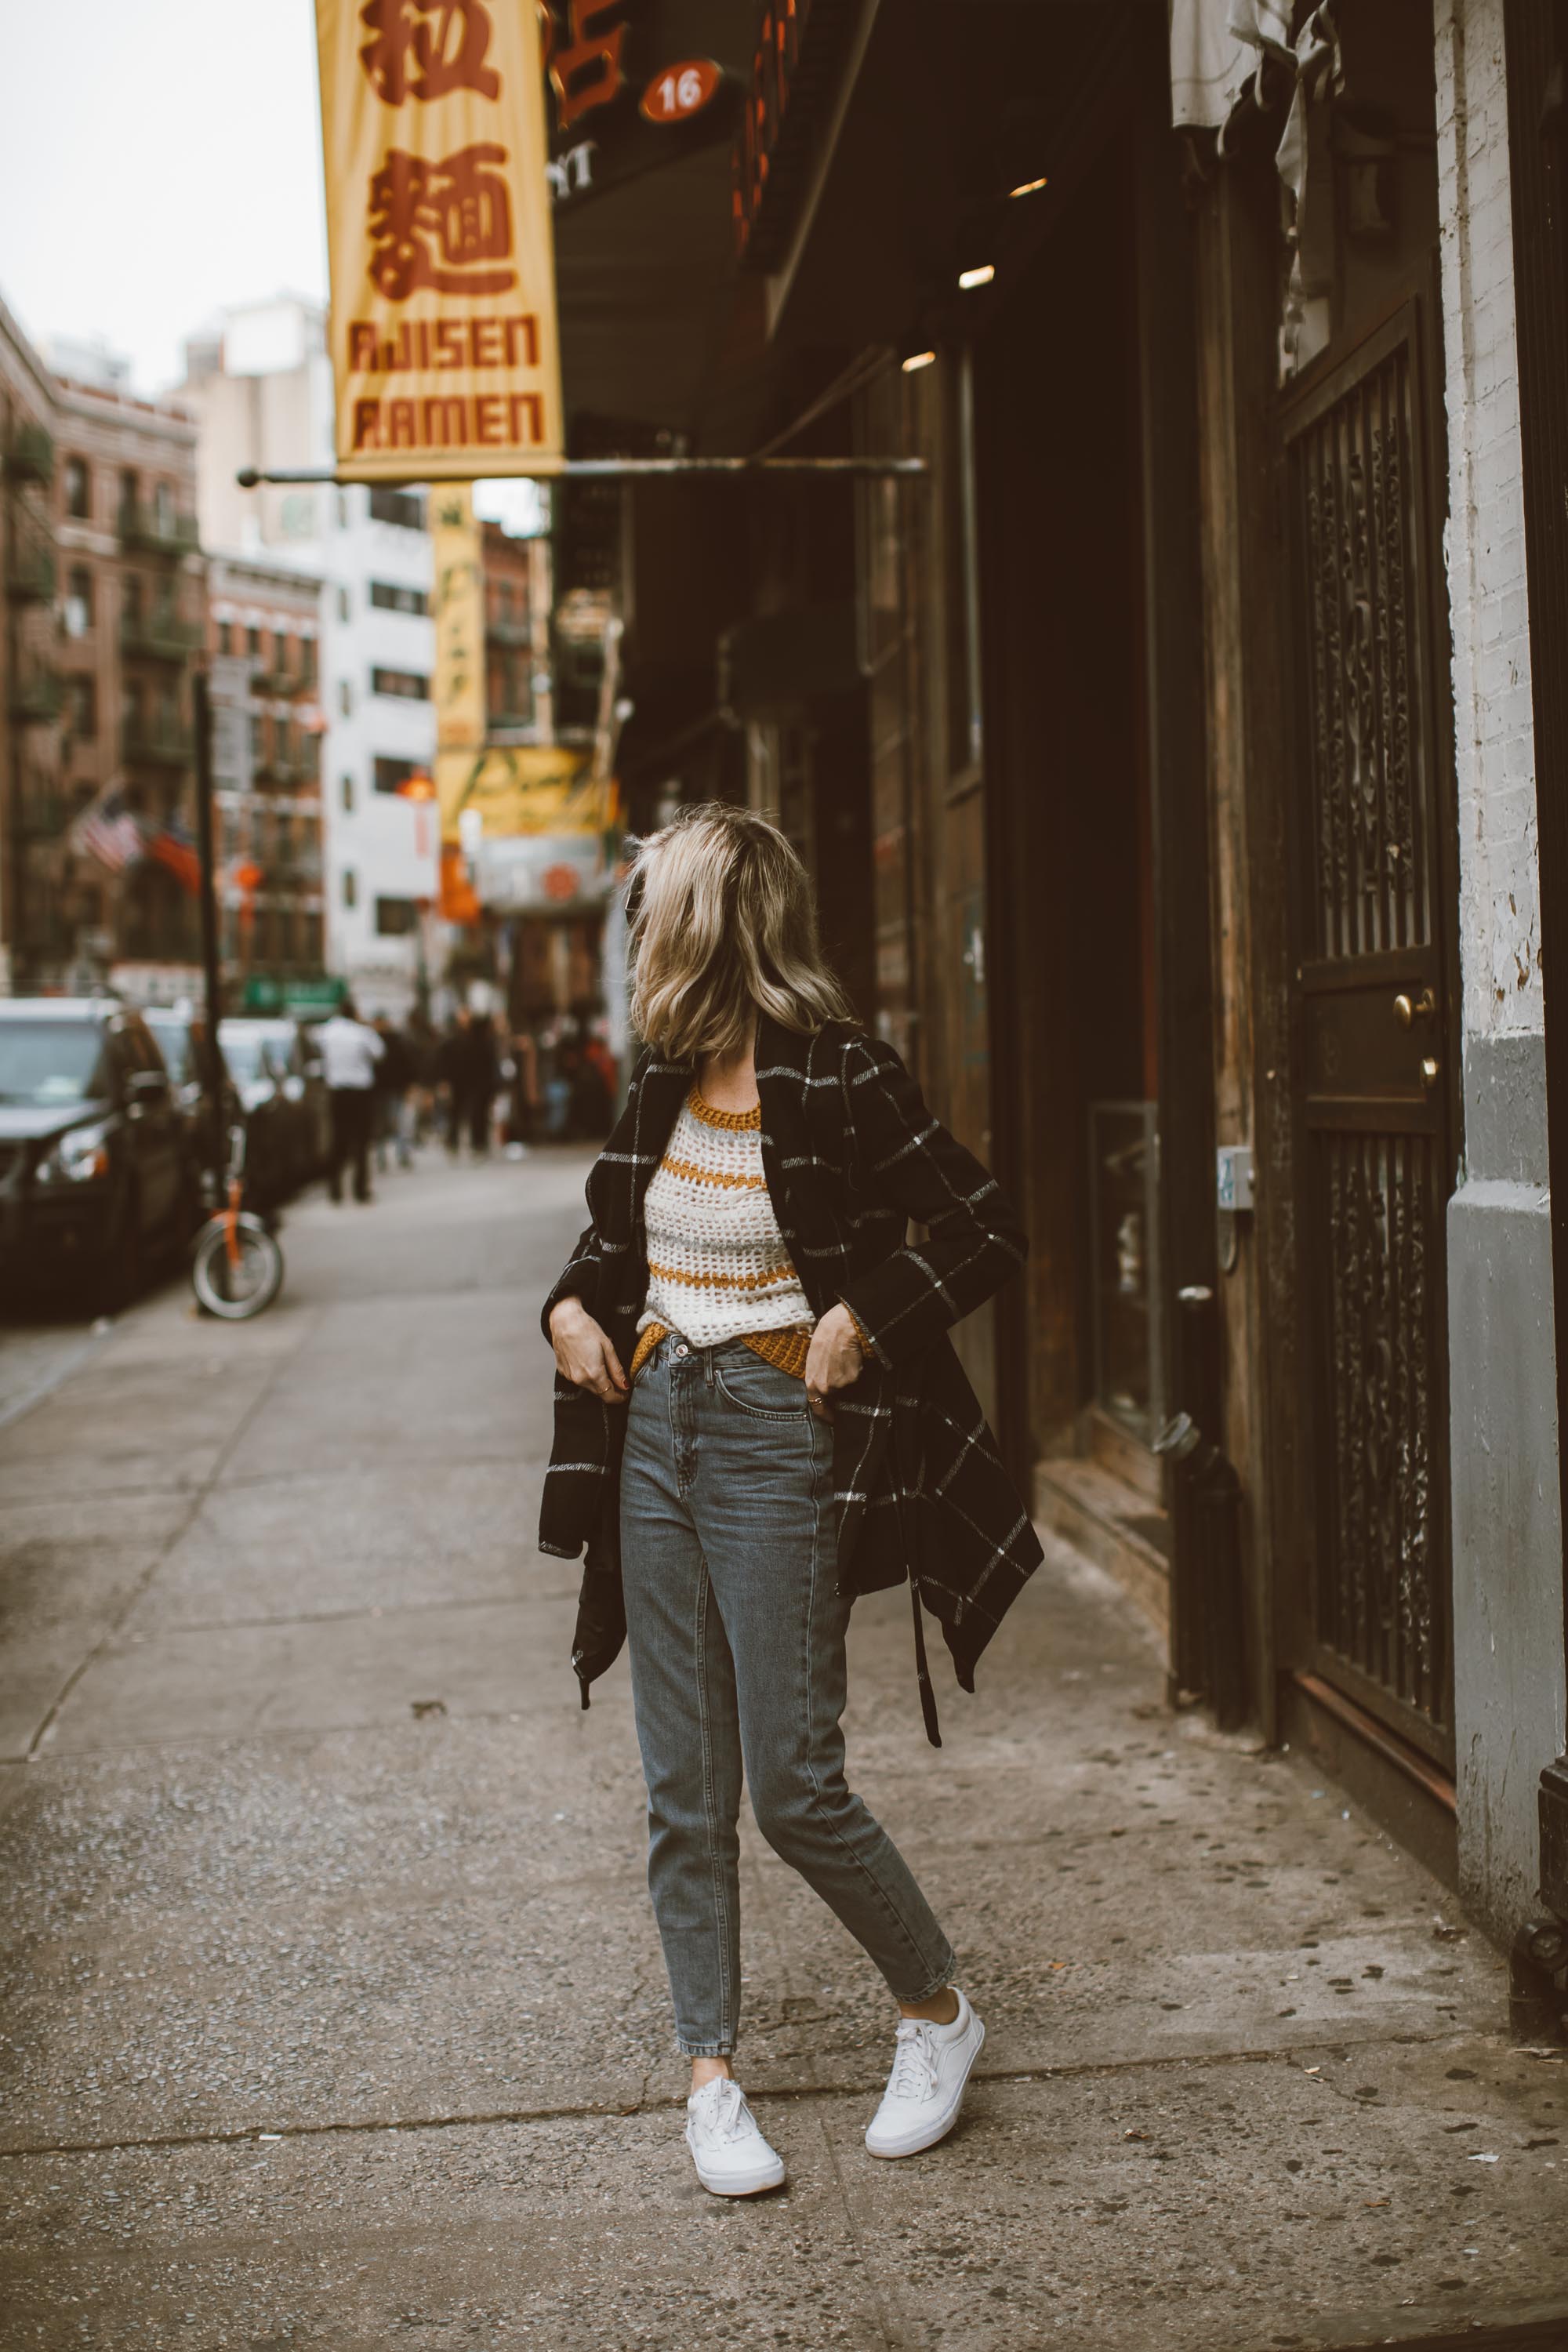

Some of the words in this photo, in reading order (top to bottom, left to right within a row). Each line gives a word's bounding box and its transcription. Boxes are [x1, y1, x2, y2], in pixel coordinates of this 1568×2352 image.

[657, 68, 702, 113] 16
[349, 314, 539, 372] AJISEN
[353, 394, 543, 449] RAMEN
